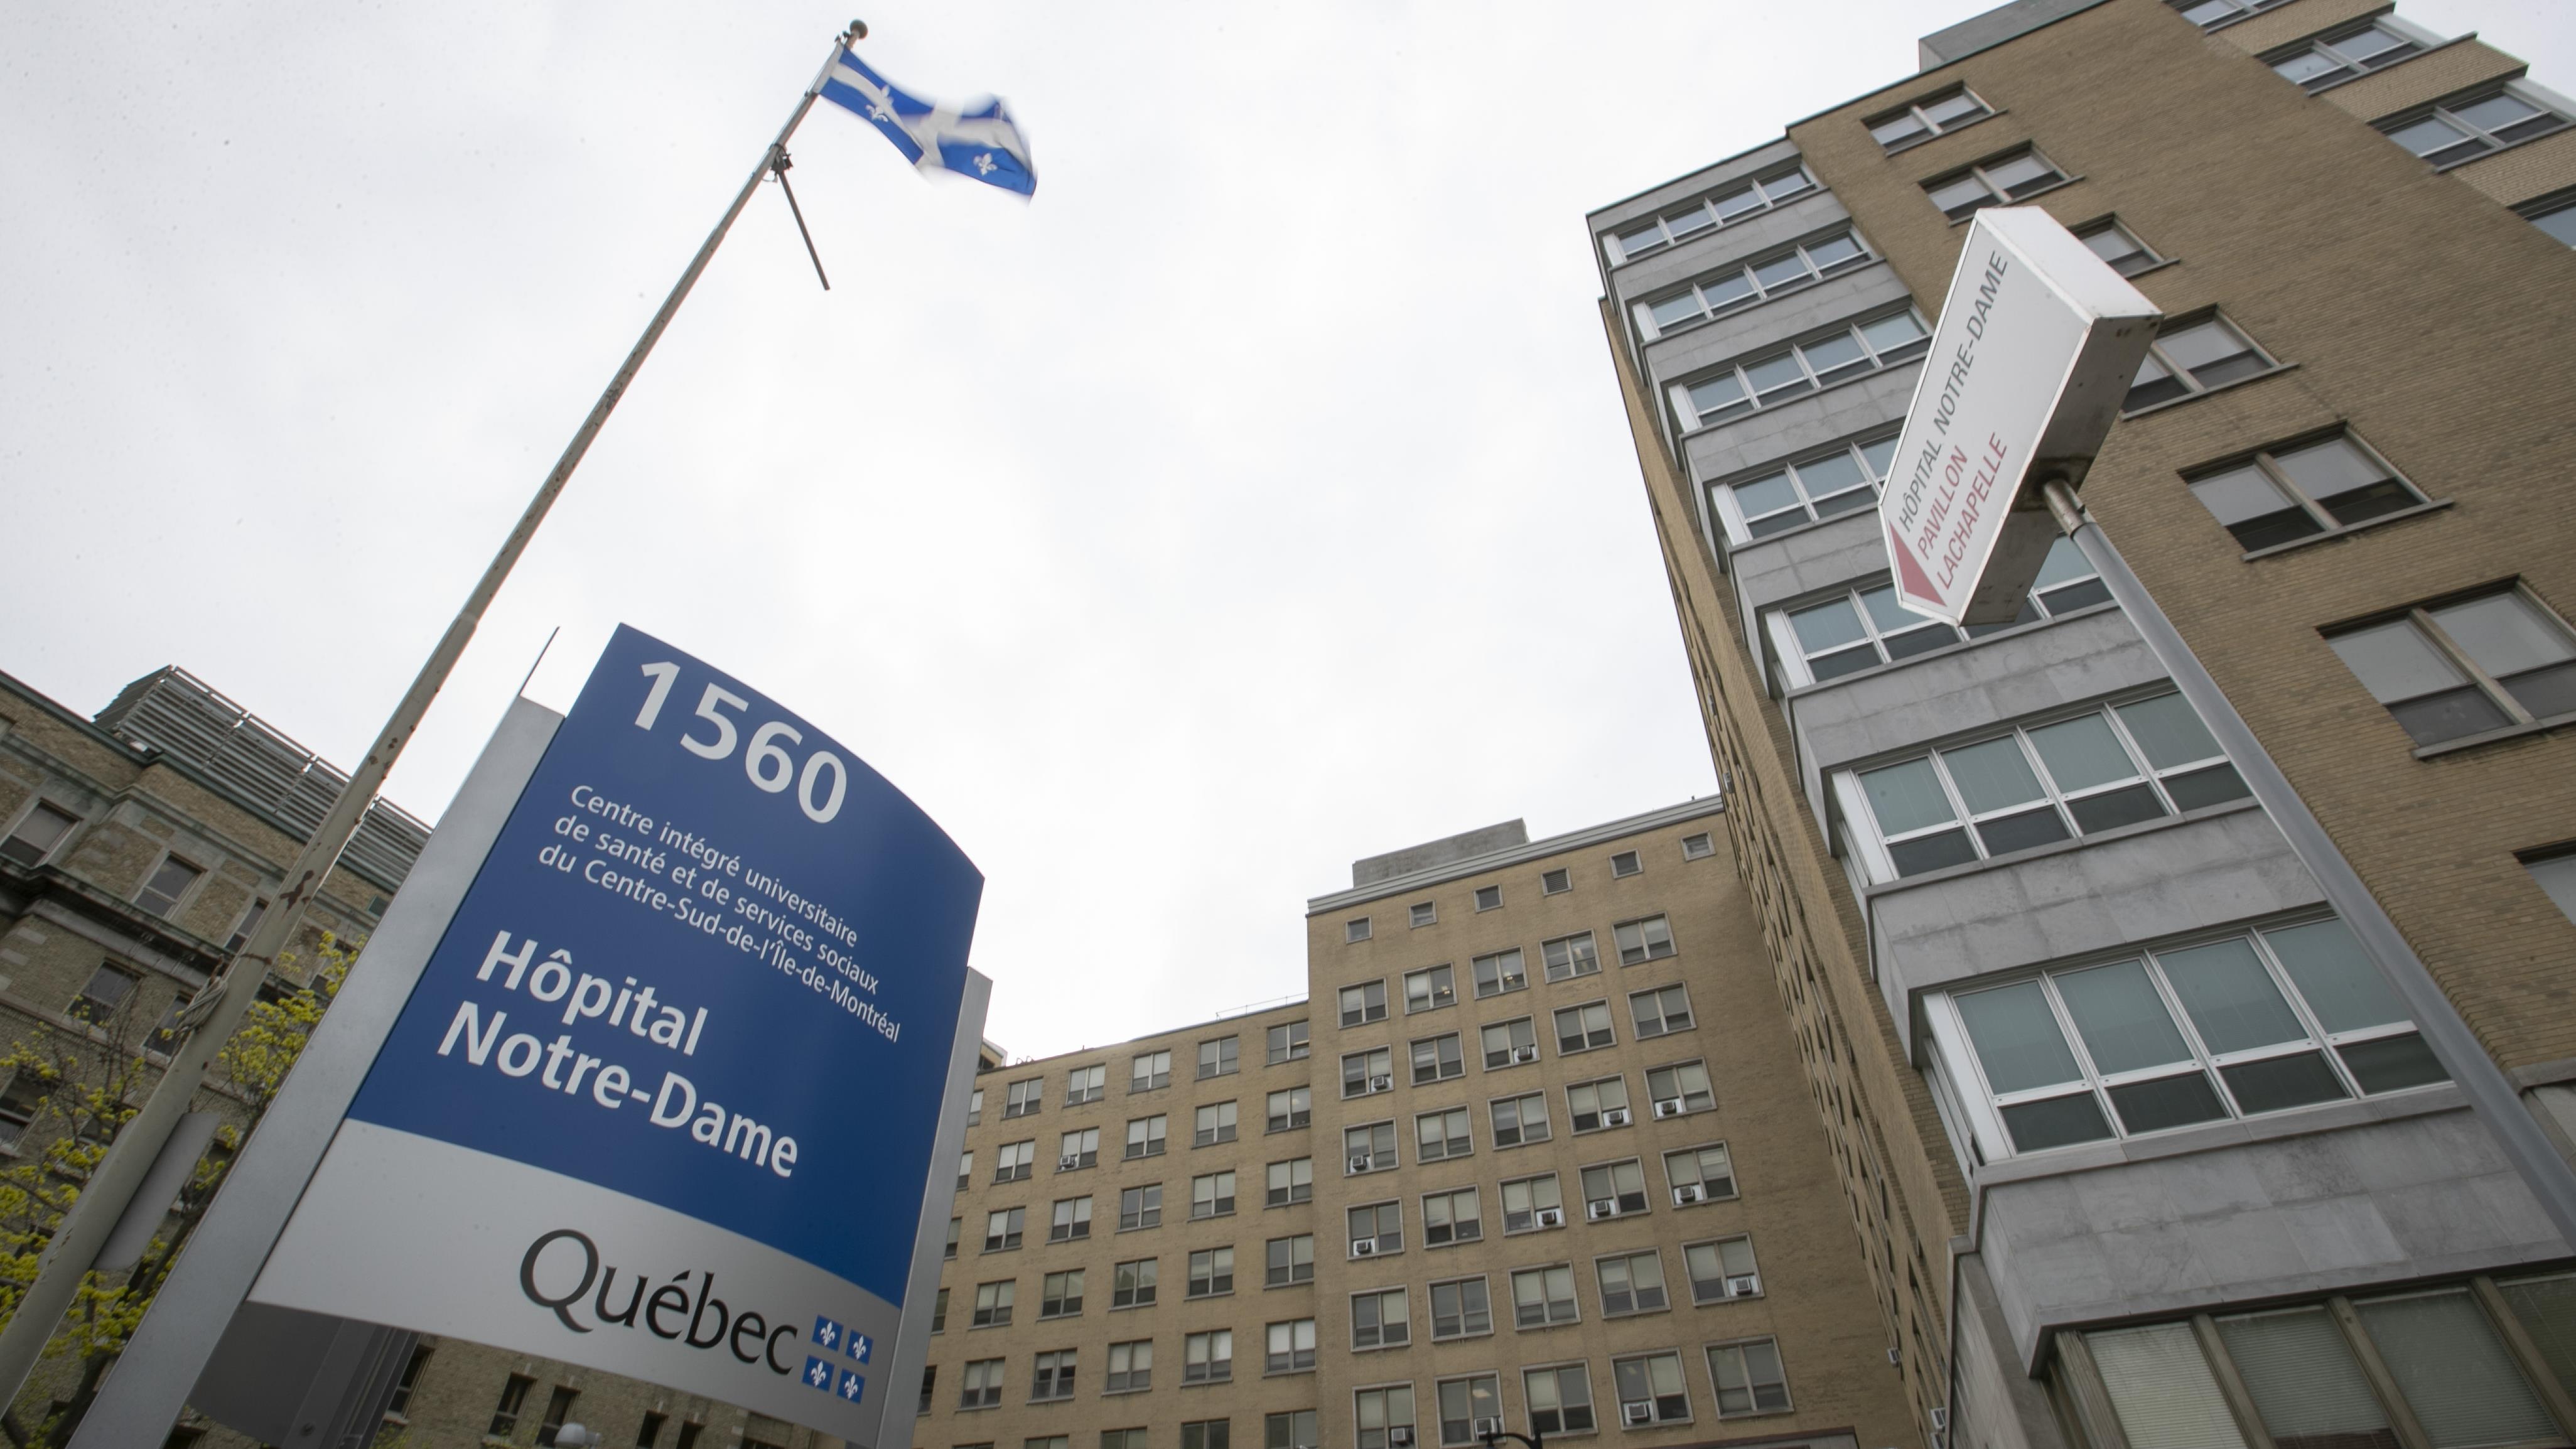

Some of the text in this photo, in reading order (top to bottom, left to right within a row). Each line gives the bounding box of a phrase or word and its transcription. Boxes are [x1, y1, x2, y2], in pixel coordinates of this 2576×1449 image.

[1899, 250, 2008, 532] HÔPITAL NOTRE-DAME
[1917, 445, 1968, 560] PAVILLON
[1937, 432, 2007, 590] LACHAPELLE
[634, 661, 847, 824] 1560
[539, 844, 576, 873] du
[554, 815, 878, 995] de santé et de services sociaux
[571, 785, 858, 947] Centre intégré universitaire
[476, 930, 708, 1056] Hôpital
[438, 1001, 797, 1177] Notre-Dame
[520, 1229, 799, 1377] Québec
